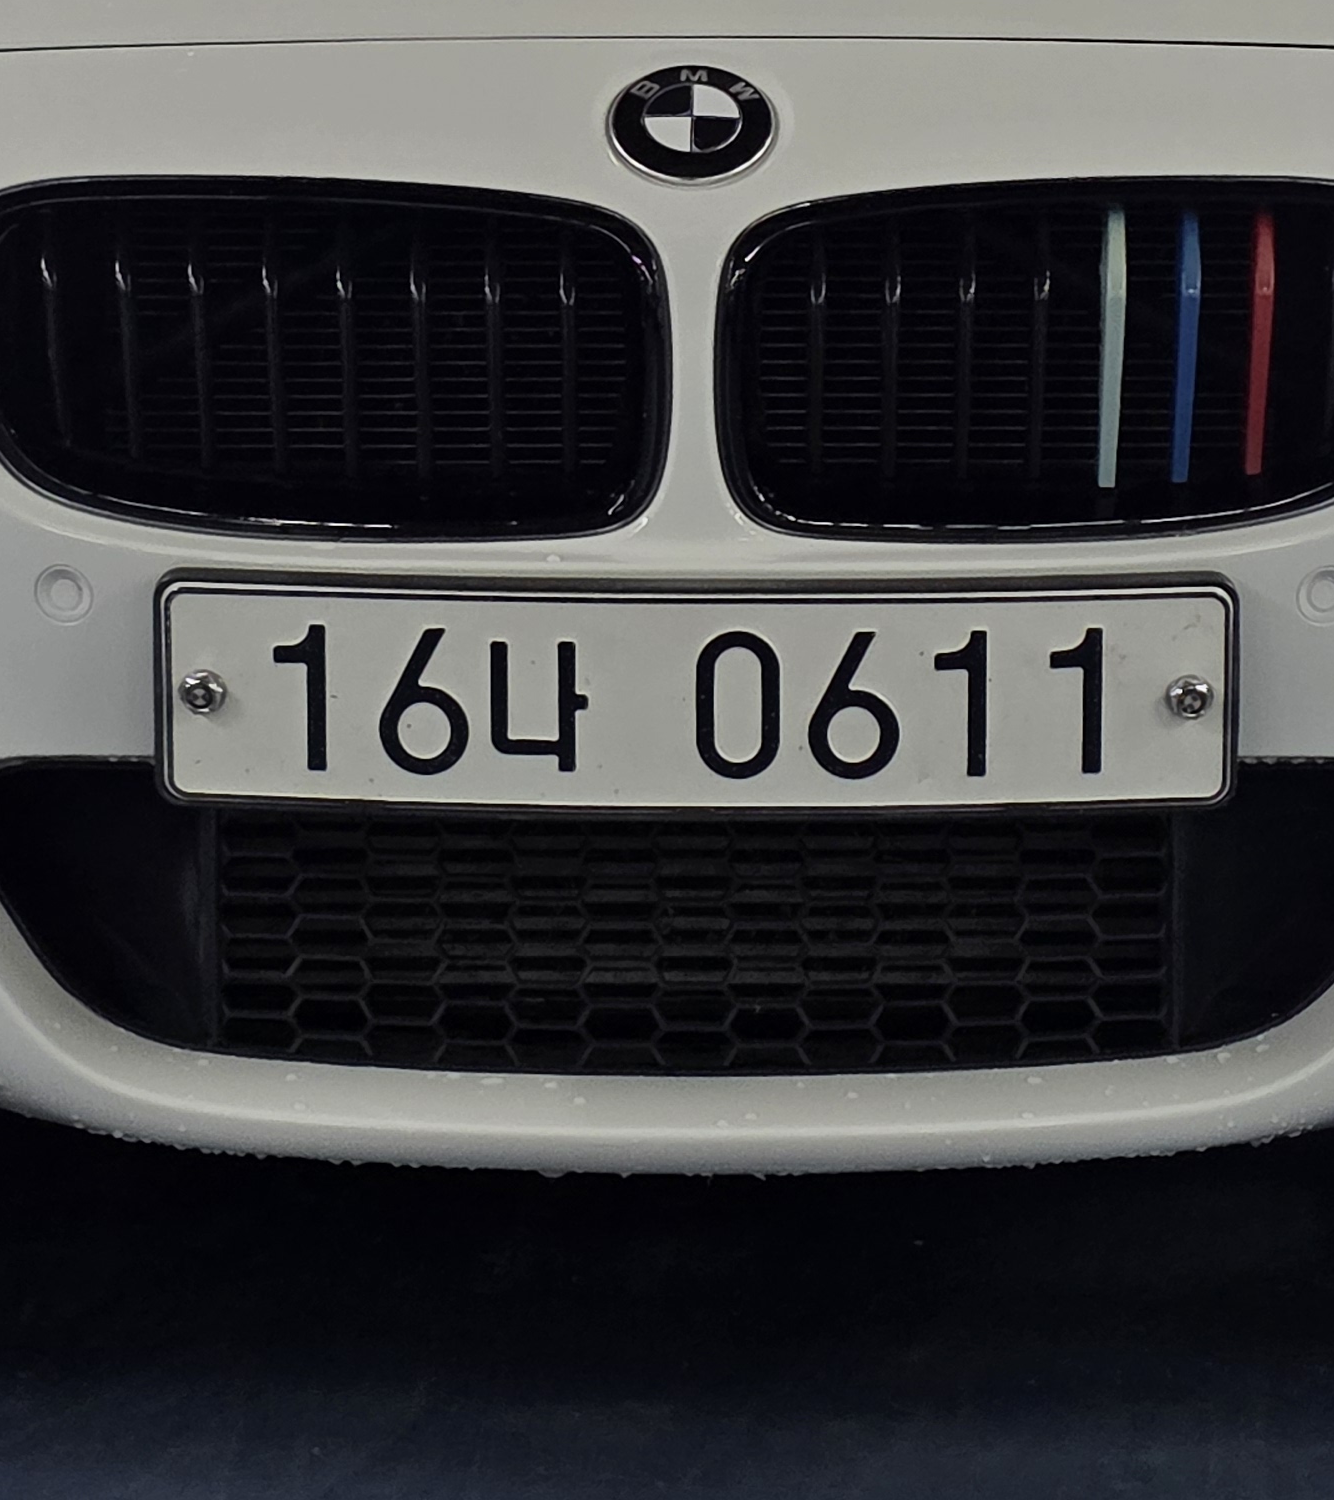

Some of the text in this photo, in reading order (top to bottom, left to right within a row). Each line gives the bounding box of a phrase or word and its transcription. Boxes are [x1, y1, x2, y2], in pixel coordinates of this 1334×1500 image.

[629, 68, 761, 101] BMW
[271, 623, 1104, 780] 16나 0611
